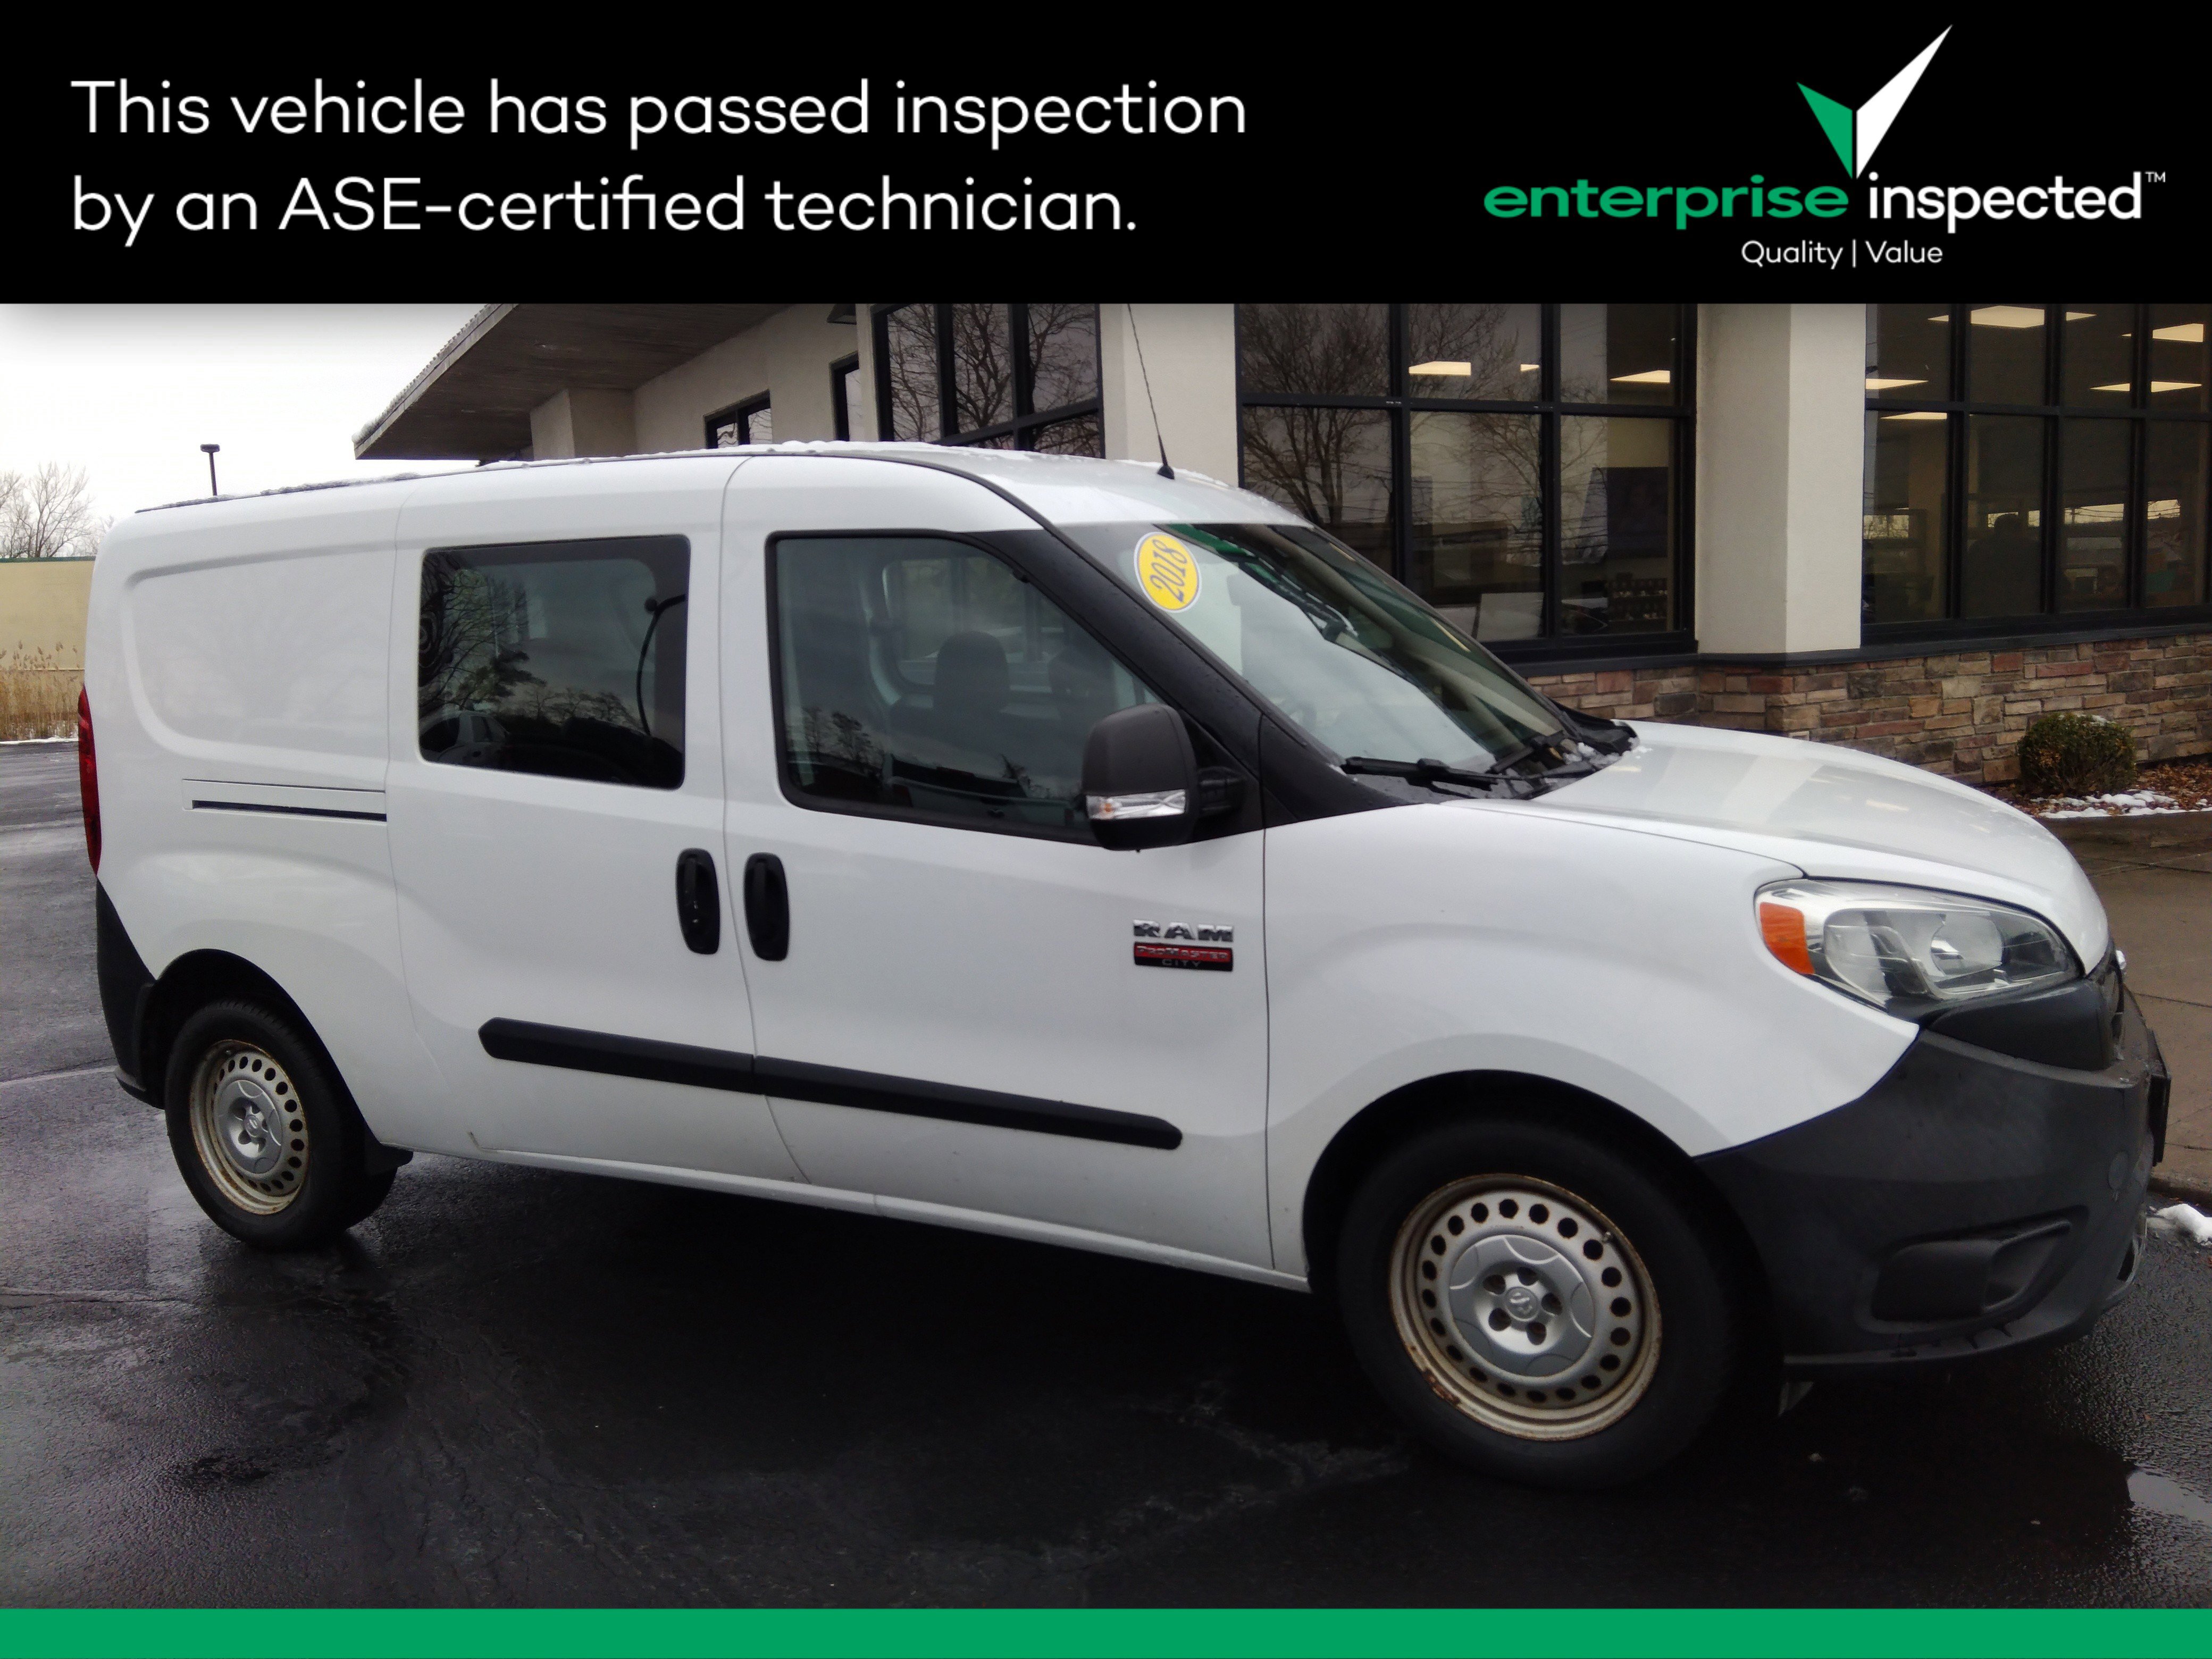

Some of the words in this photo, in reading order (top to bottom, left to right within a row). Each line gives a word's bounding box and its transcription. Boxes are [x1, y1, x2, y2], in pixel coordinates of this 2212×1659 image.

[1150, 539, 1187, 602] 2018
[1133, 920, 1233, 942] RAM
[1162, 959, 1201, 968] CITY
